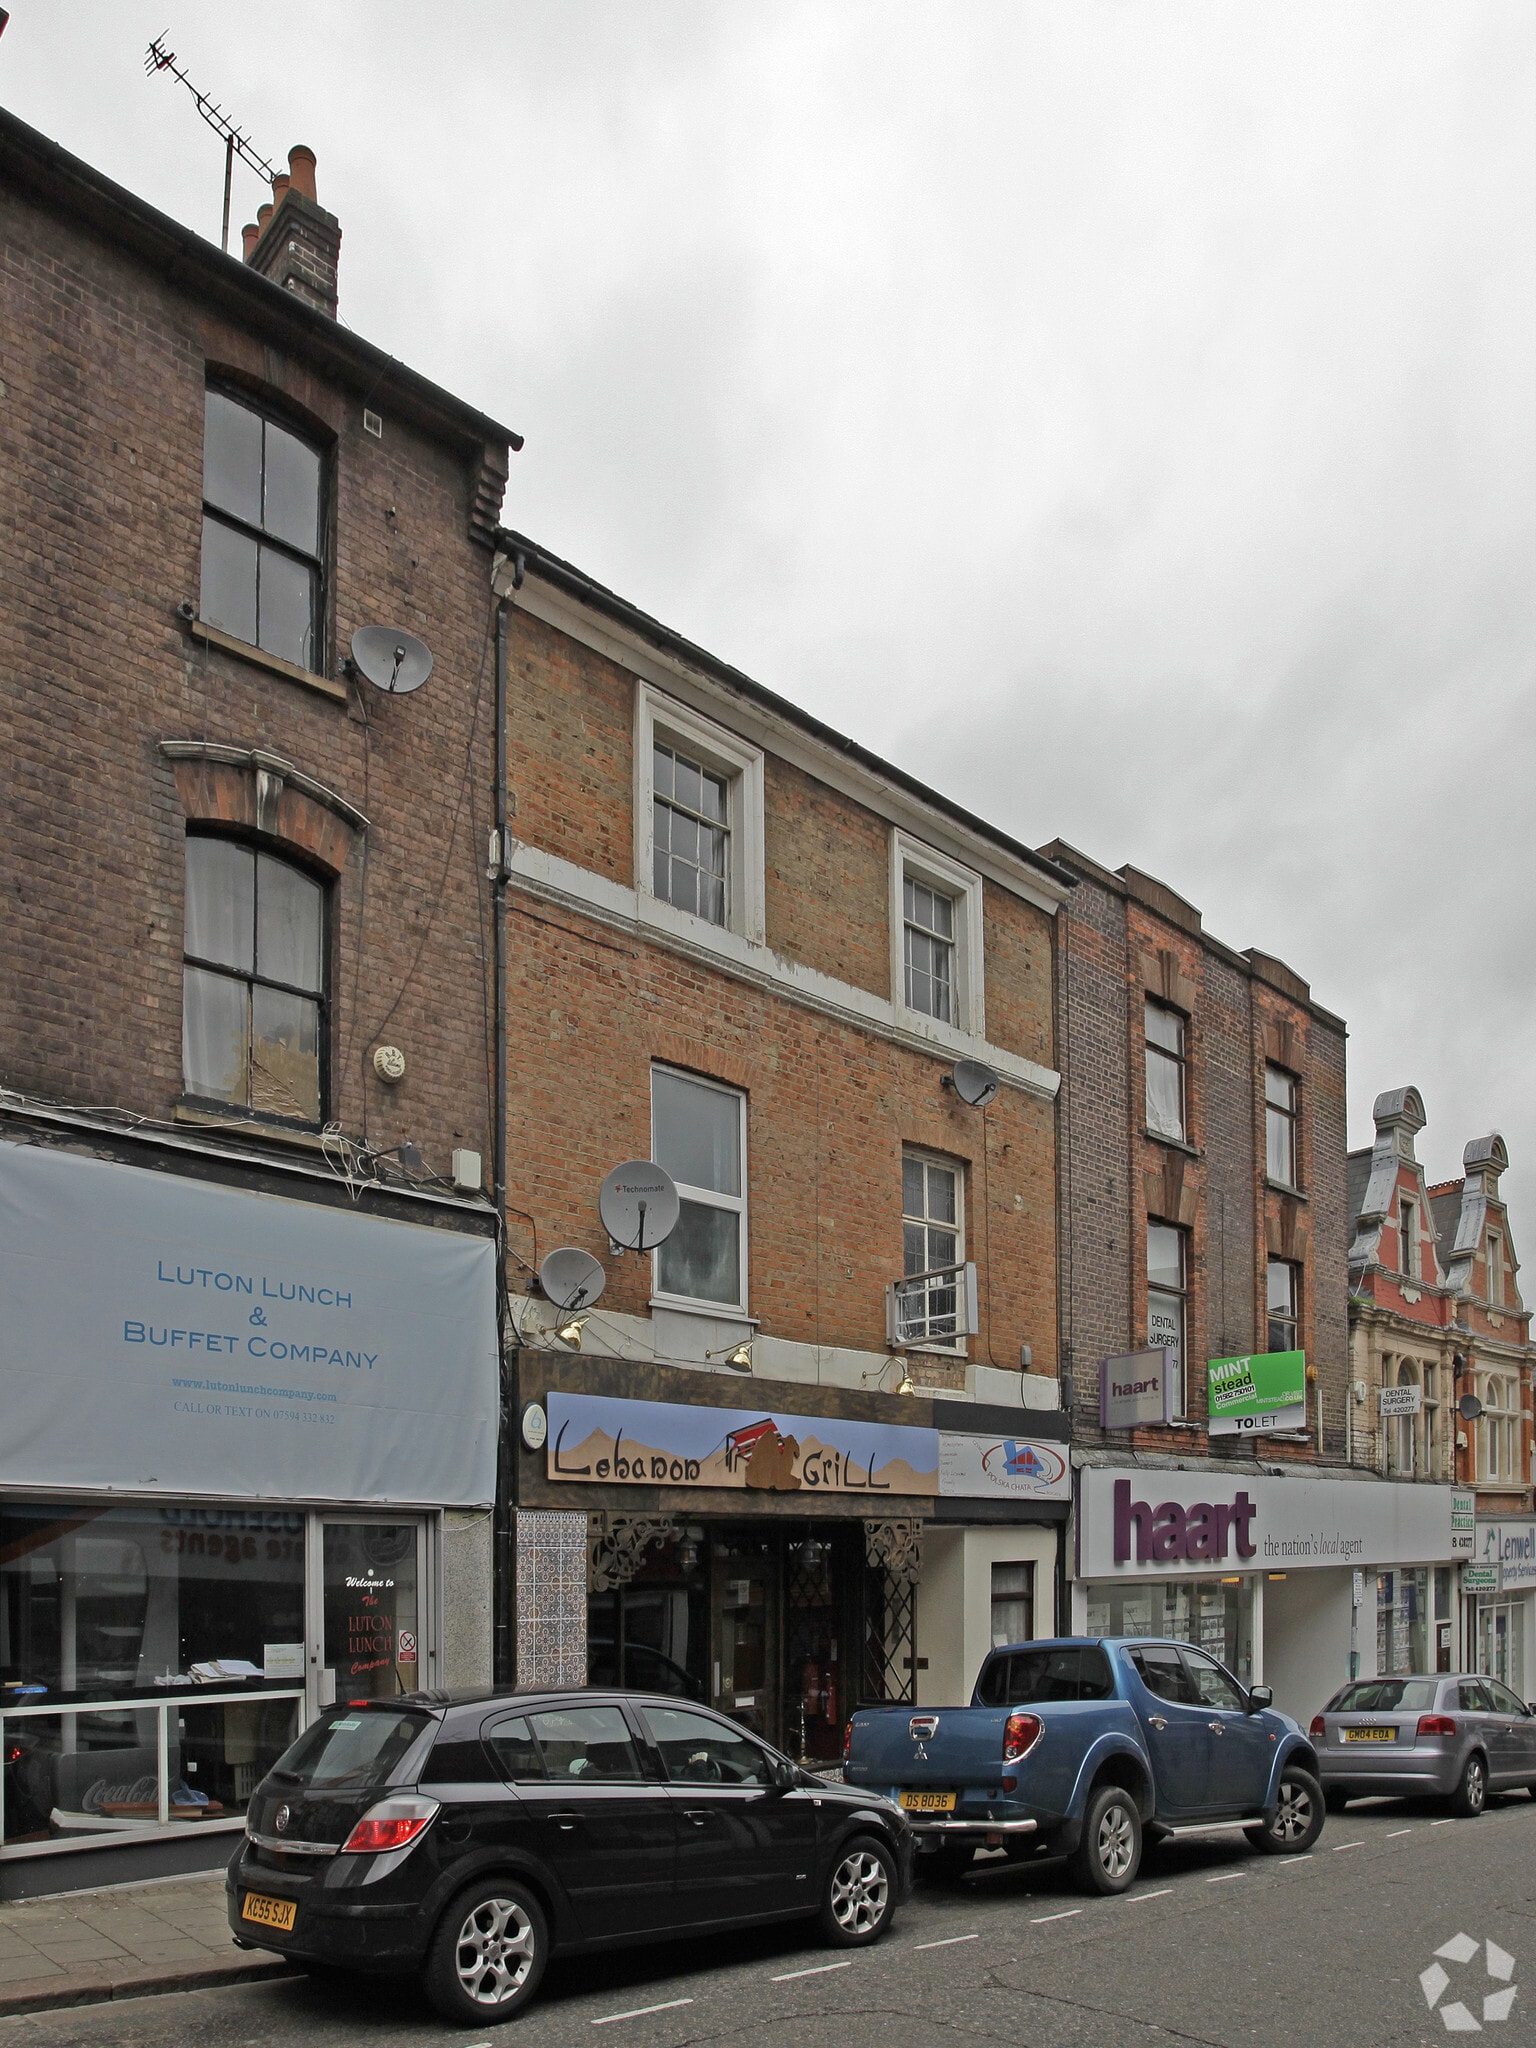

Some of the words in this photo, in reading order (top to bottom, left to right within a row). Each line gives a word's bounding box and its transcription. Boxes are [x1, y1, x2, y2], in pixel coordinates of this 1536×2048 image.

[623, 1185, 665, 1193] Technomate
[158, 1261, 252, 1294] LUTON
[262, 1277, 352, 1308] LUNCH
[249, 1306, 267, 1326] &
[1151, 1315, 1176, 1331] DENTAL
[124, 1321, 239, 1353] BUFFET
[248, 1337, 378, 1369] COMPANY
[1209, 1357, 1251, 1383] MINT
[171, 1378, 337, 1401] www.lutonlunchcompany.com
[1112, 1377, 1159, 1397] haart
[1215, 1372, 1252, 1394] stead
[1216, 1393, 1257, 1410] Commercial
[1382, 1396, 1415, 1405] SURGERY
[1385, 1389, 1412, 1397] DENTAL
[174, 1401, 205, 1414] CALL
[206, 1403, 222, 1415] OR
[224, 1405, 253, 1418] TEXT
[255, 1408, 271, 1419] ON
[273, 1409, 300, 1421] 07594
[302, 1412, 317, 1423] 332
[319, 1414, 335, 1424] 832
[554, 1418, 701, 1481] Lebanon
[986, 1471, 1010, 1489] POLSKA
[1011, 1483, 1032, 1491] CHATA
[1453, 1497, 1472, 1511] Dental
[1114, 1479, 1257, 1562] haart
[1264, 1534, 1279, 1556] the
[1281, 1533, 1318, 1556] nation's
[1319, 1532, 1338, 1555] local
[1340, 1537, 1363, 1561] agent
[1451, 1515, 1474, 1528] Practice
[1498, 1527, 1536, 1562] Lenwell
[345, 1576, 384, 1588] Welcome
[385, 1577, 394, 1587] to
[1463, 1577, 1497, 1586] Surgeons
[1468, 1570, 1493, 1578] Dental
[362, 1595, 379, 1608] The
[348, 1615, 392, 1633] LUTON
[349, 1636, 392, 1653] LUNCH
[350, 1656, 391, 1676] Company
[905, 1794, 919, 1808] DS
[921, 1794, 949, 1808] 8036
[272, 1902, 293, 1926] SJX
